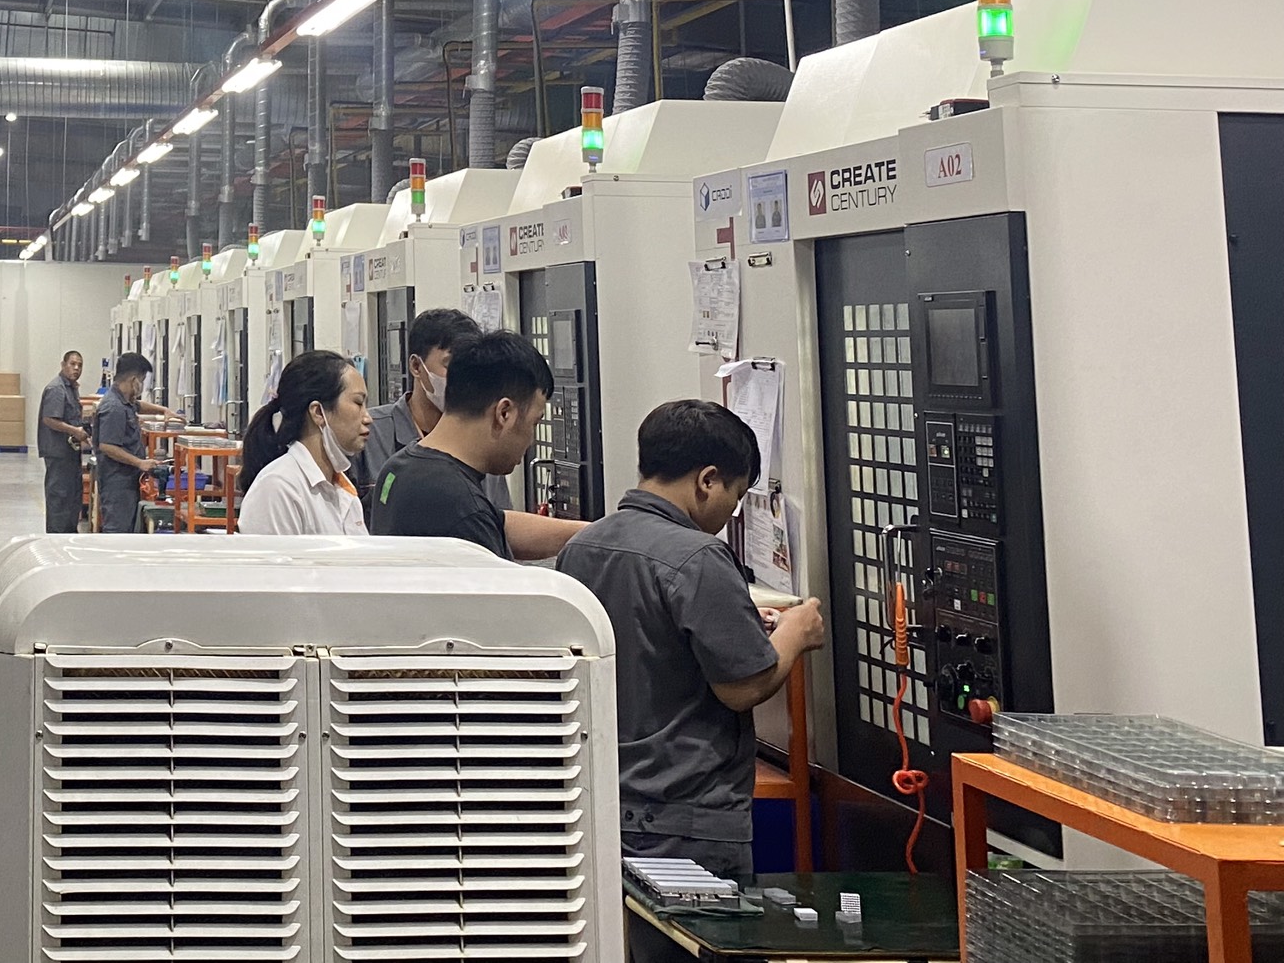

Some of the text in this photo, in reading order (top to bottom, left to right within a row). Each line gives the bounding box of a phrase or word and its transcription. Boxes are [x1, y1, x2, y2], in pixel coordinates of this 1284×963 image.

[830, 158, 897, 190] CREATE
[937, 153, 962, 179] A02
[831, 184, 897, 212] CENTURY
